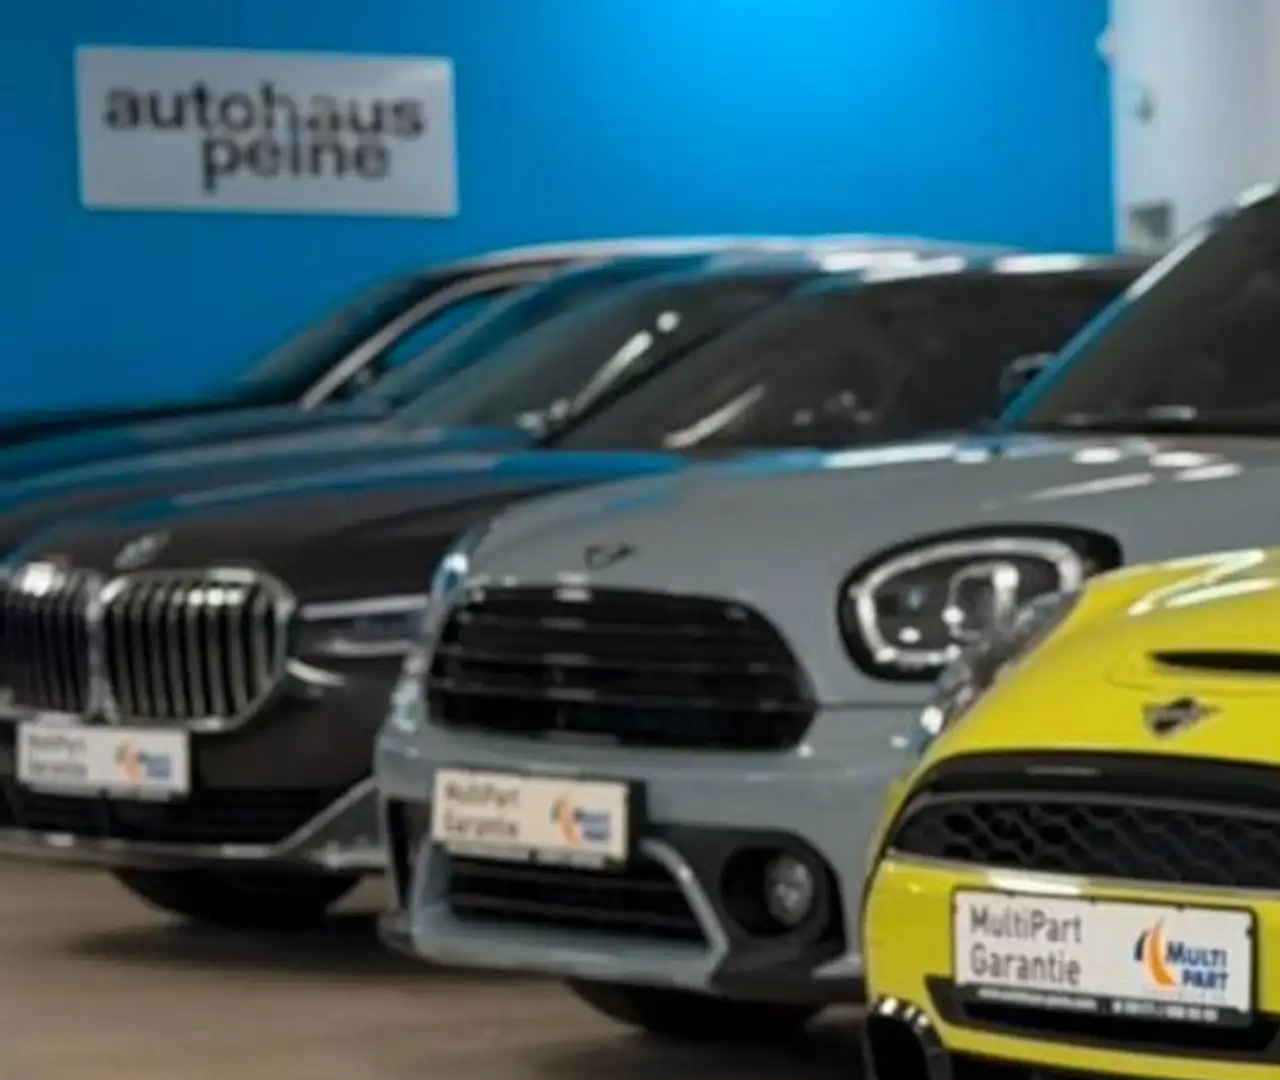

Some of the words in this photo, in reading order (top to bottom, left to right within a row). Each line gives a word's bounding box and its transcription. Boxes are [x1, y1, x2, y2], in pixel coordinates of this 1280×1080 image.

[104, 80, 428, 140] autohaus
[201, 132, 391, 194] peine
[969, 903, 1082, 944] MultiPart
[970, 941, 1082, 986] Garantie
